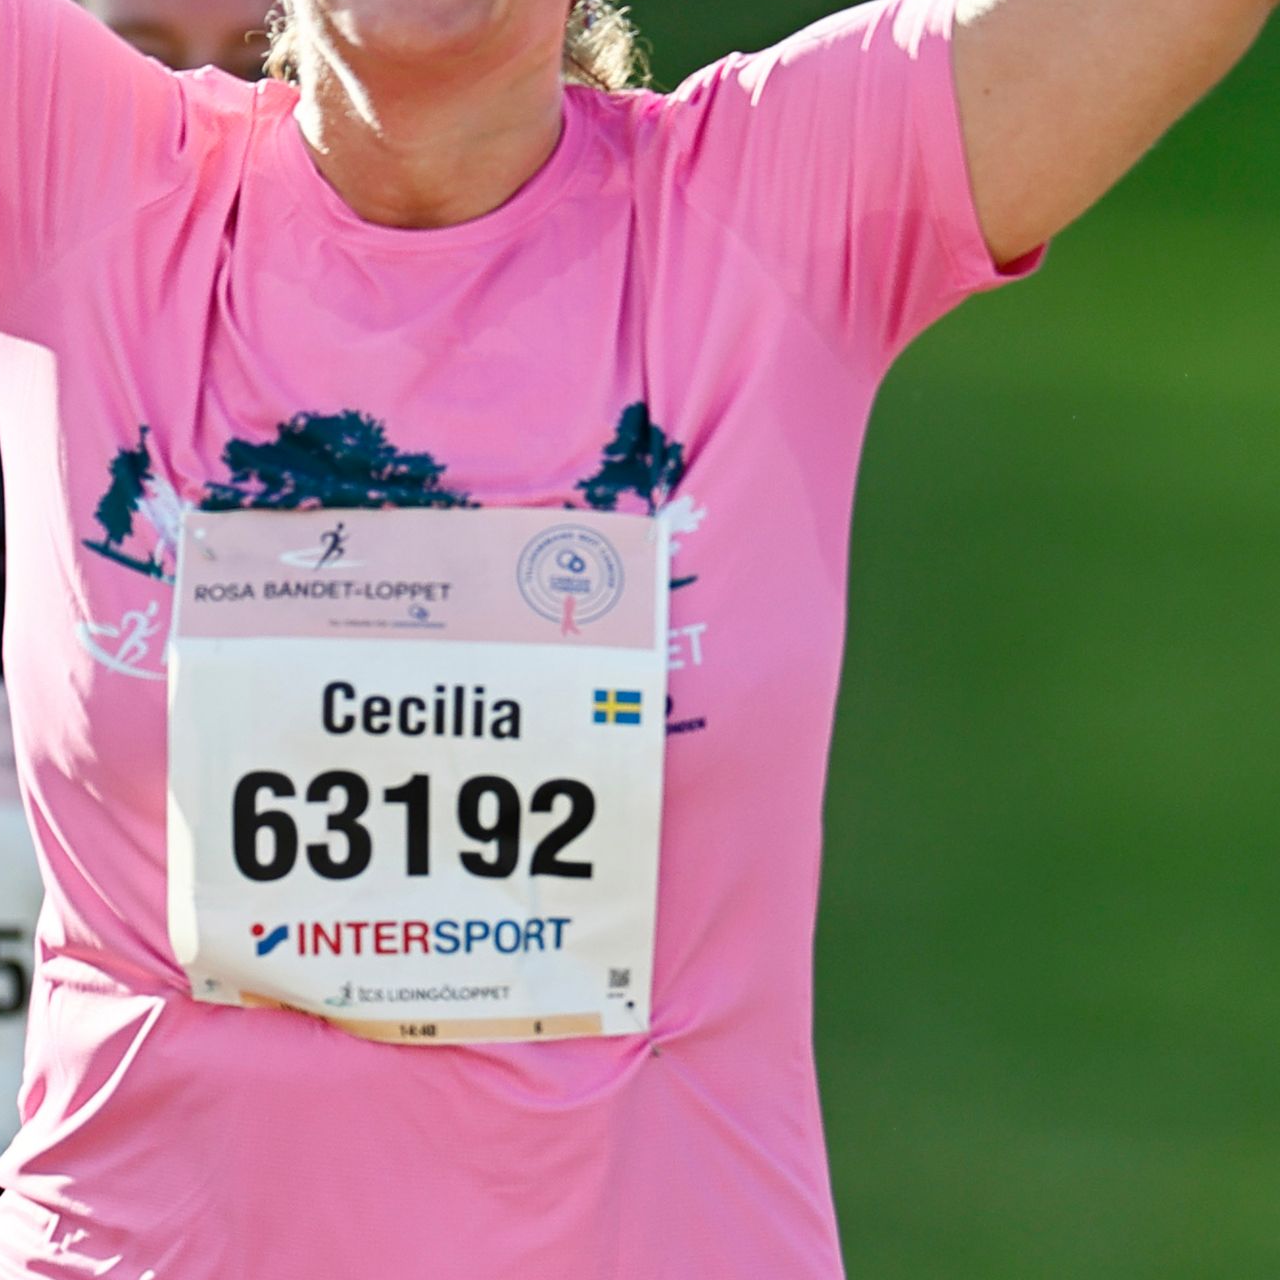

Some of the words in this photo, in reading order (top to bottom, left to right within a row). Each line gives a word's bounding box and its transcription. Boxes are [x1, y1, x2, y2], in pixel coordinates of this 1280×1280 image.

[194, 581, 255, 602] ROSA
[263, 579, 451, 601] BANDET-LOPPET
[321, 681, 522, 740] Cecilia
[232, 769, 596, 883] 63192
[298, 918, 572, 956] INTERSPORT
[387, 985, 510, 1002] LIDINGÖLOPPET
